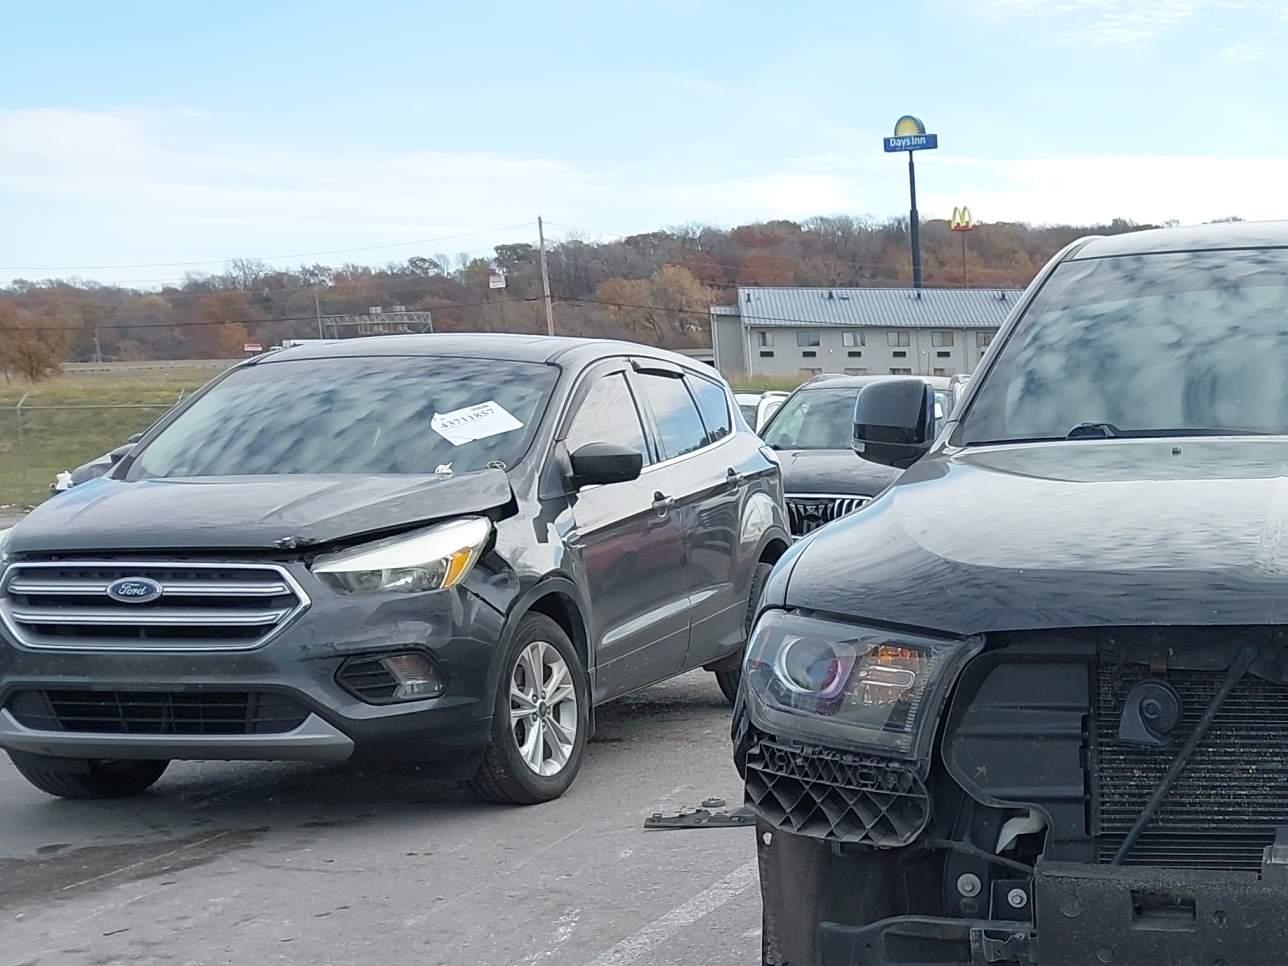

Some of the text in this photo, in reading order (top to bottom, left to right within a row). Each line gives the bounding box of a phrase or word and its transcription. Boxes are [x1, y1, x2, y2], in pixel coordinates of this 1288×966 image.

[890, 136, 926, 148] Days Inn
[118, 583, 147, 595] Ford
